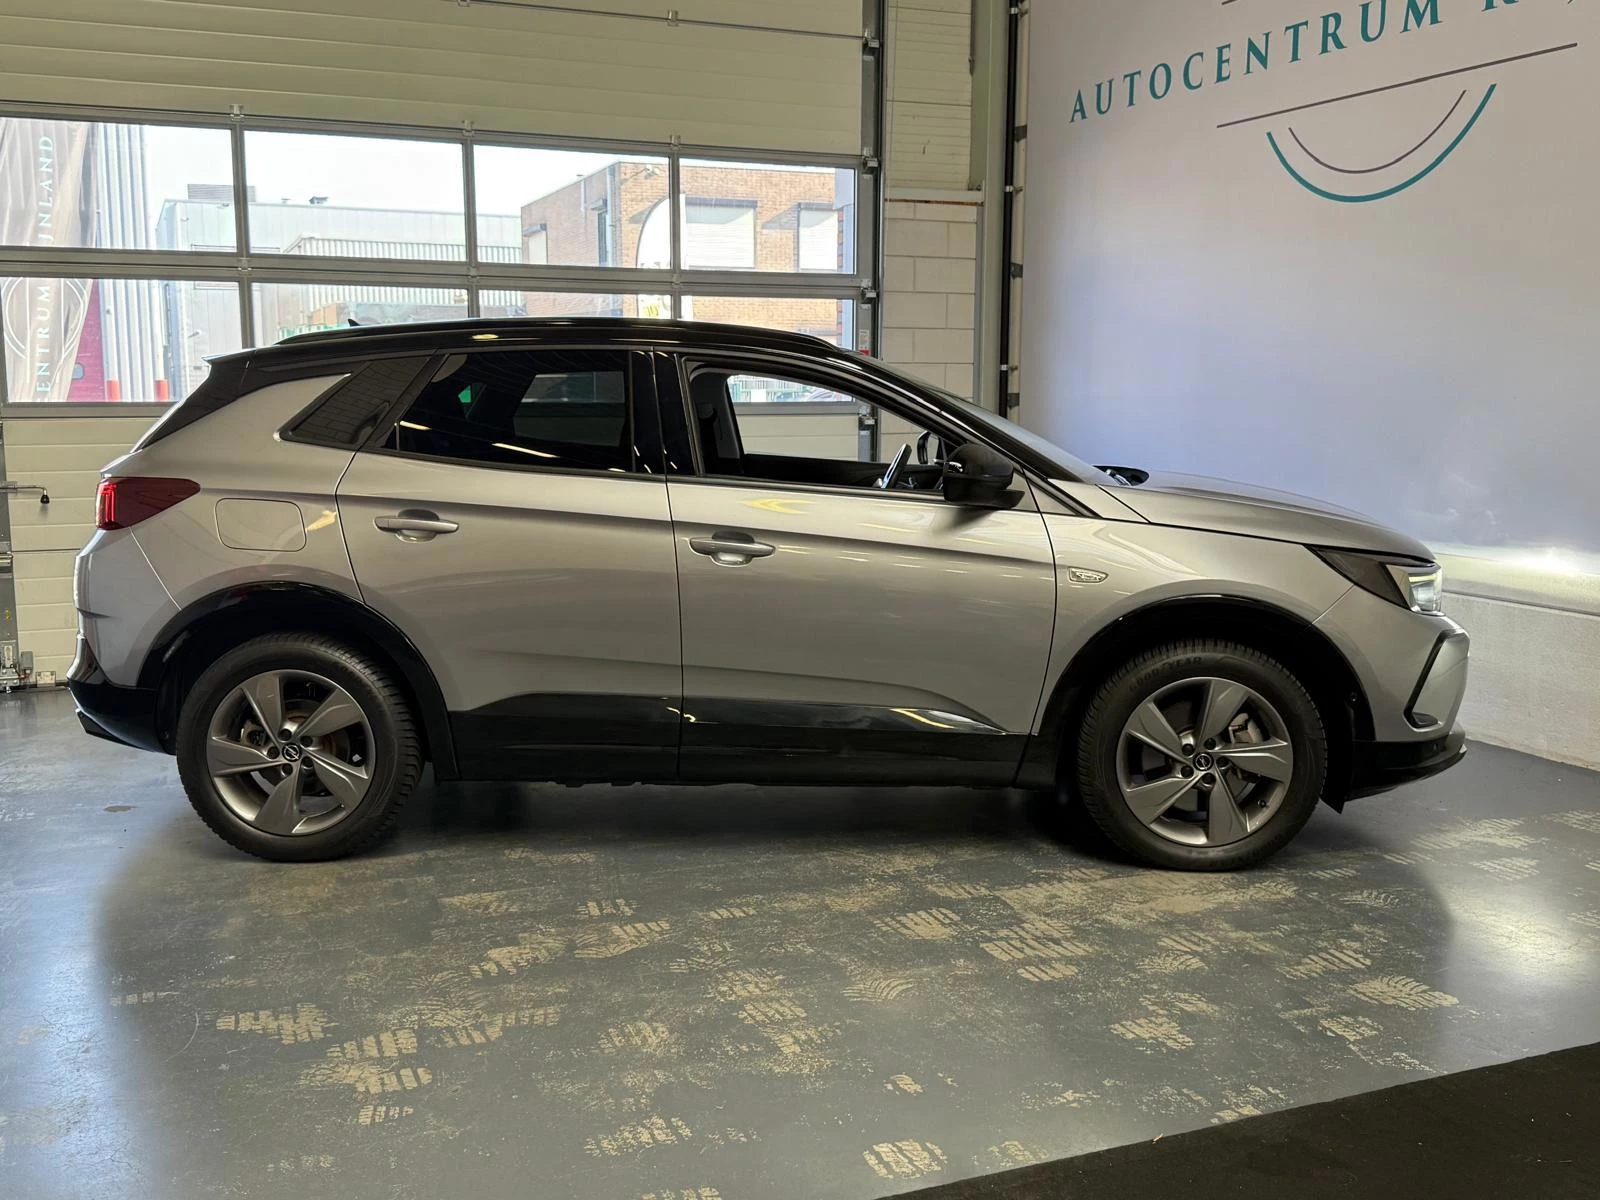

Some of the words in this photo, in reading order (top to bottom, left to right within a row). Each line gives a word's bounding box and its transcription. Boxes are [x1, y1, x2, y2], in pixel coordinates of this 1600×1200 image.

[1069, 0, 1443, 123] AUTOCENTRUM
[38, 135, 55, 243] JNLAND
[36, 286, 51, 400] ENTRUM
